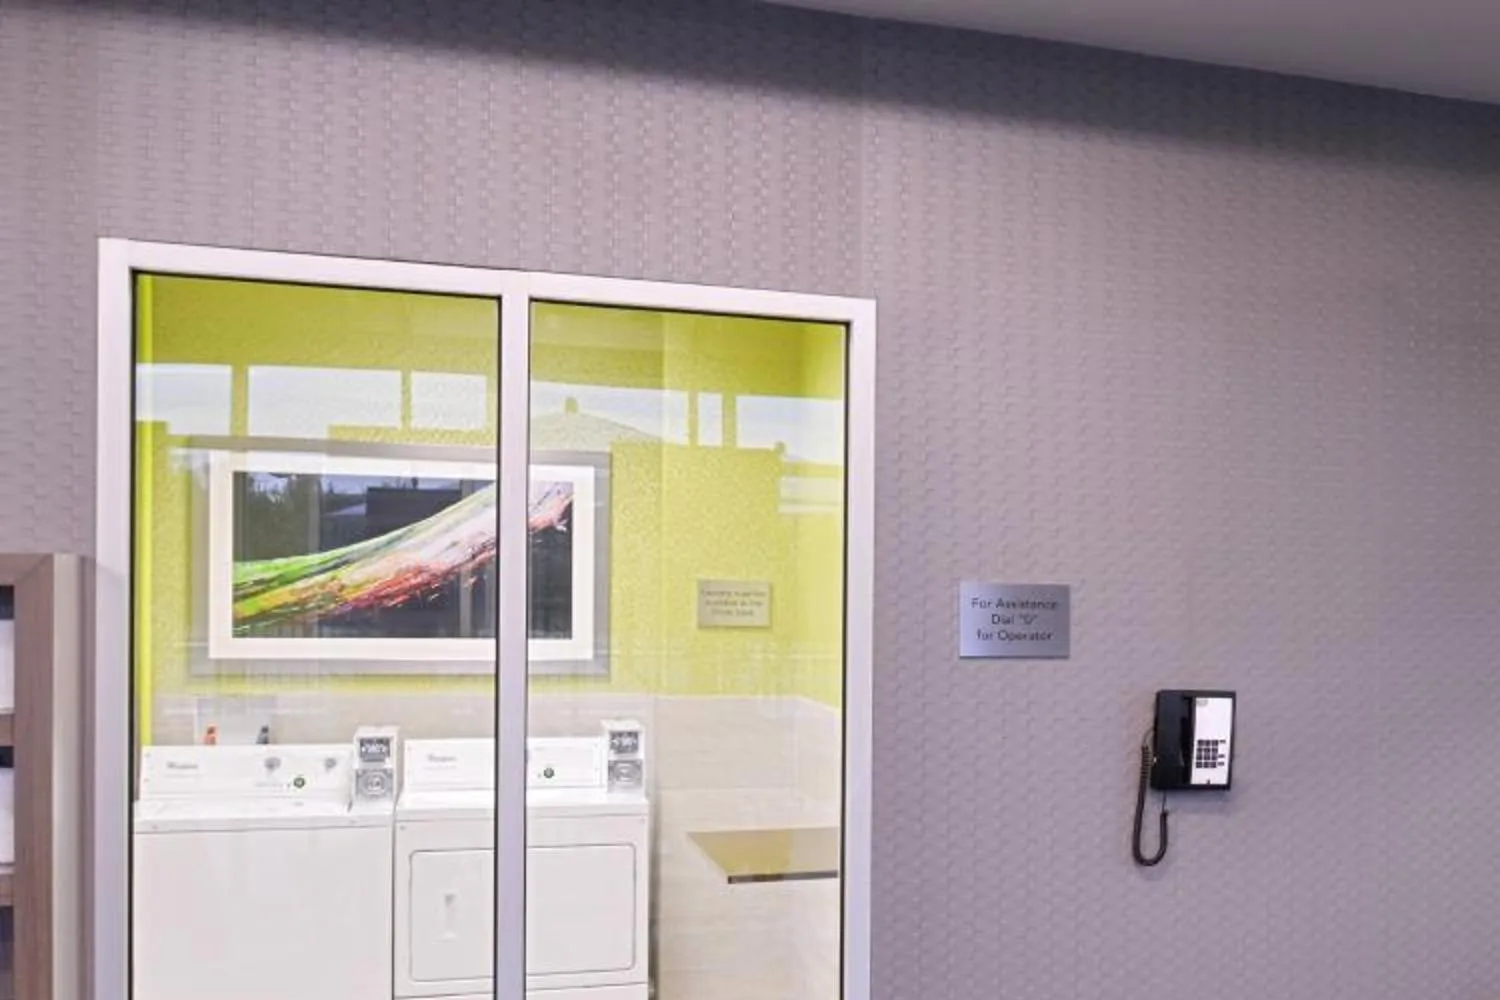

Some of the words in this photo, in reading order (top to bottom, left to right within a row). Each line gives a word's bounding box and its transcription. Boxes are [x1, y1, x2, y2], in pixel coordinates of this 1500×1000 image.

[971, 597, 992, 609] For
[995, 597, 1058, 610] Assistance
[991, 613, 1015, 625] Dial
[997, 629, 1054, 643] Operator
